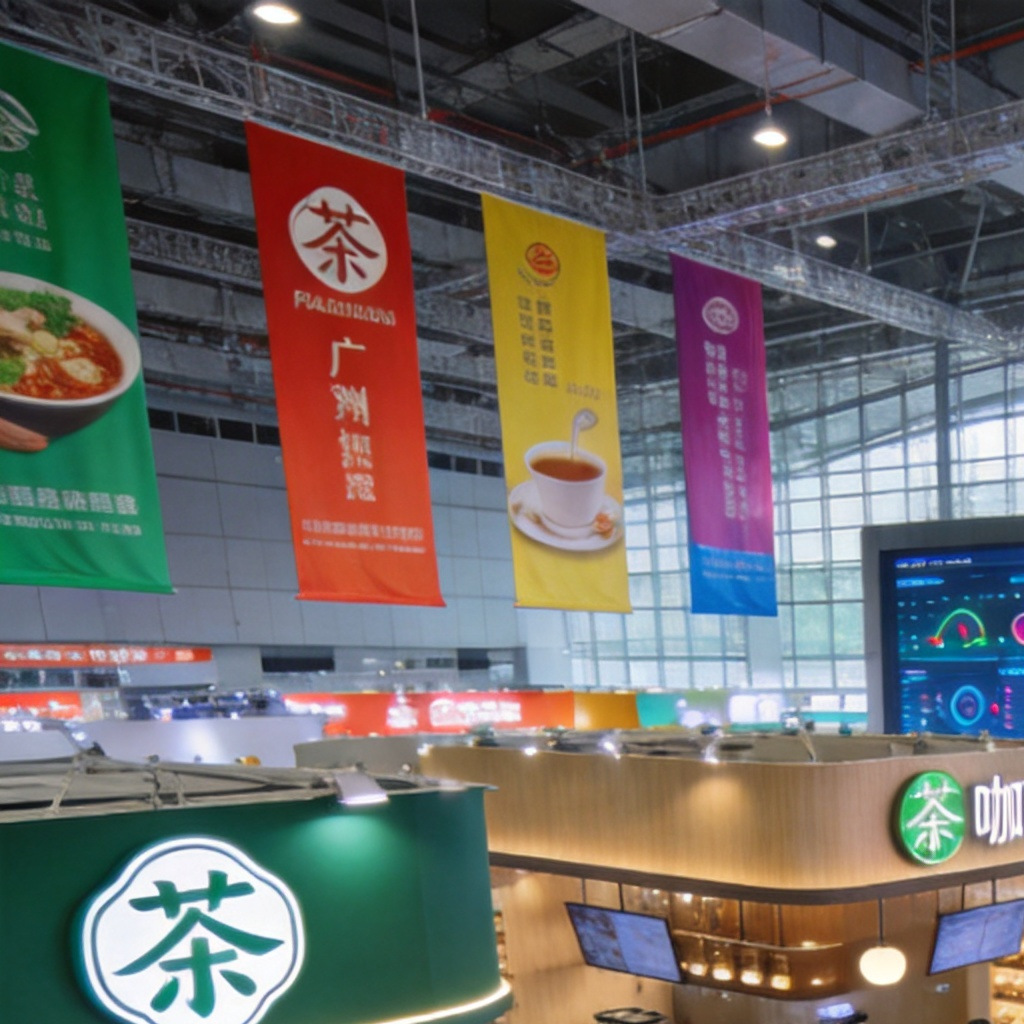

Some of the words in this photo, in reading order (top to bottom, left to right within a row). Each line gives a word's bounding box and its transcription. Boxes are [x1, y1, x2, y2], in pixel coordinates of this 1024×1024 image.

[303, 198, 380, 285] 茶
[906, 780, 964, 854] 茶
[113, 870, 284, 1018] 茶
